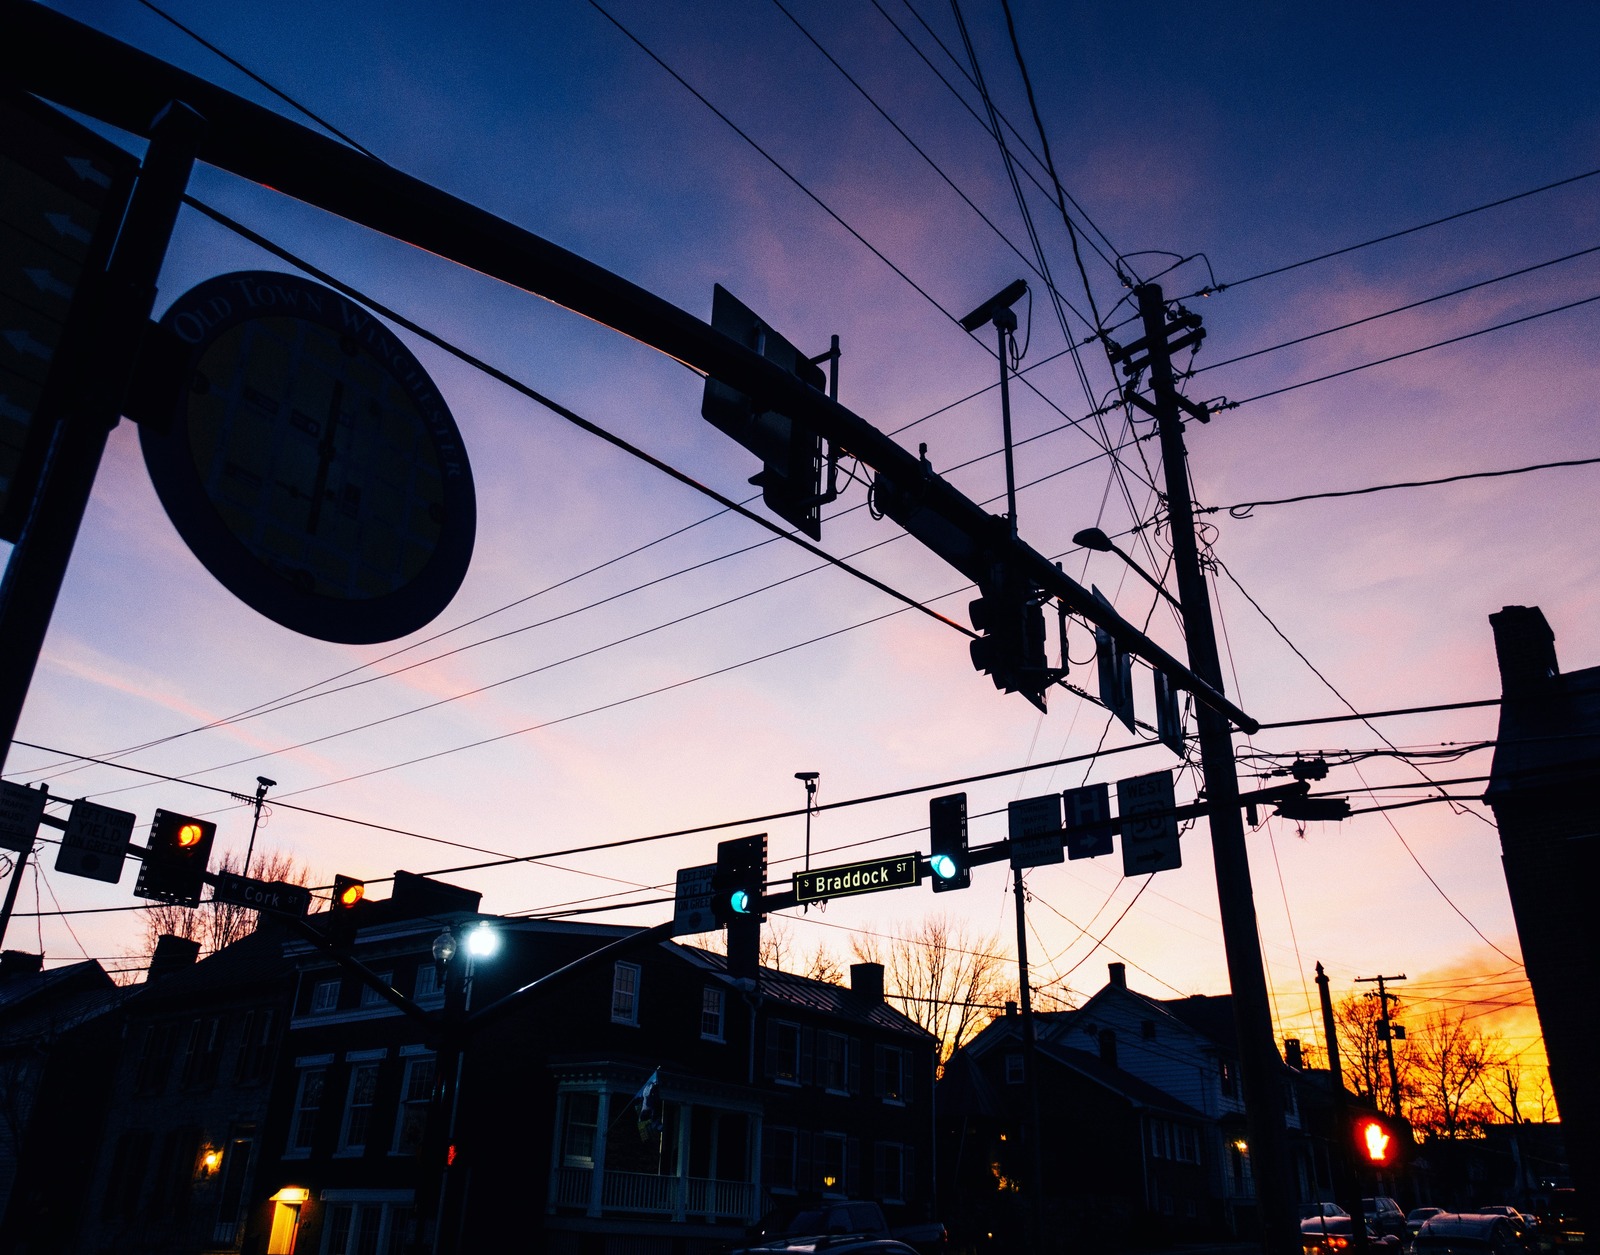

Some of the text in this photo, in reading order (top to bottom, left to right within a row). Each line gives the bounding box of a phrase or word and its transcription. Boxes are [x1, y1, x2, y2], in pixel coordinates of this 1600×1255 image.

[173, 296, 233, 345] OLD
[230, 277, 323, 314] TOWN
[336, 297, 462, 480] WINCHESTER
[1127, 779, 1163, 798] WEST
[75, 806, 132, 828] LEFT TURN
[1073, 790, 1102, 828] H
[78, 821, 121, 842] YIELD
[68, 834, 123, 855] ON GREEN
[803, 862, 907, 893] S Braddock ST
[231, 882, 299, 908] W Cork ST
[678, 900, 689, 912] ON
